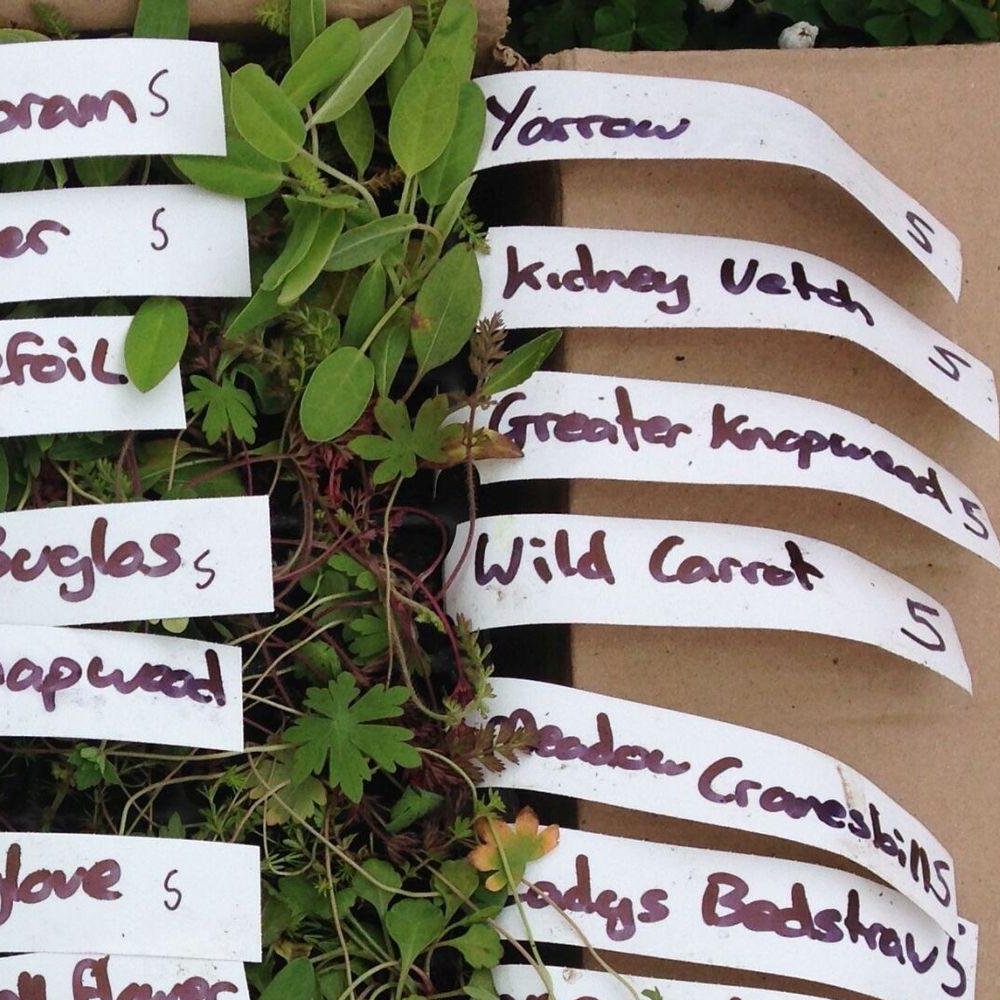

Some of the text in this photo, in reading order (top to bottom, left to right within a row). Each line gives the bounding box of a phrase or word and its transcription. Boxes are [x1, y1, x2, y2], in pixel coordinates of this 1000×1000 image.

[486, 85, 691, 151] Yarrow
[502, 243, 690, 315] Kidney
[720, 258, 874, 326] Vetch
[489, 386, 692, 458] Greater
[475, 529, 616, 587] Wild
[648, 535, 824, 591] Carrot
[510, 855, 670, 941] adys
